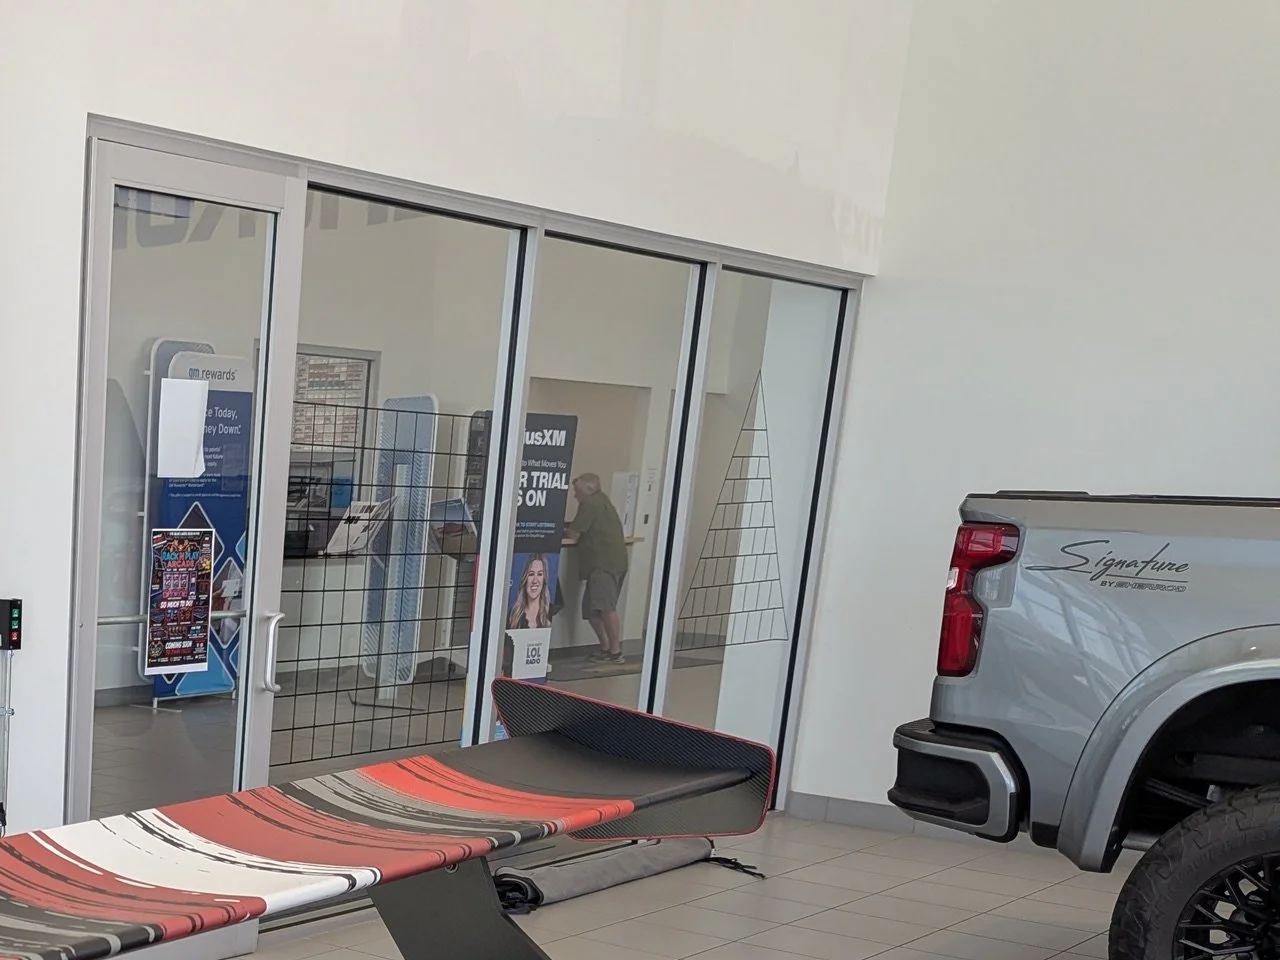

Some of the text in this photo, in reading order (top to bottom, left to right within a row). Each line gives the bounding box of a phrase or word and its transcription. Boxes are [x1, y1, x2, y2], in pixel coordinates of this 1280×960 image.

[214, 406, 238, 421] Today,
[528, 459, 541, 467] What
[541, 460, 557, 468] Moves
[557, 461, 567, 469] You
[530, 471, 569, 490] TRIAL
[525, 489, 547, 507] ON
[167, 560, 195, 568] ARCADE
[1025, 539, 1190, 581] Signature
[1114, 581, 1187, 593] SHERROD
[165, 641, 182, 650] COMING
[526, 646, 541, 658] LOL
